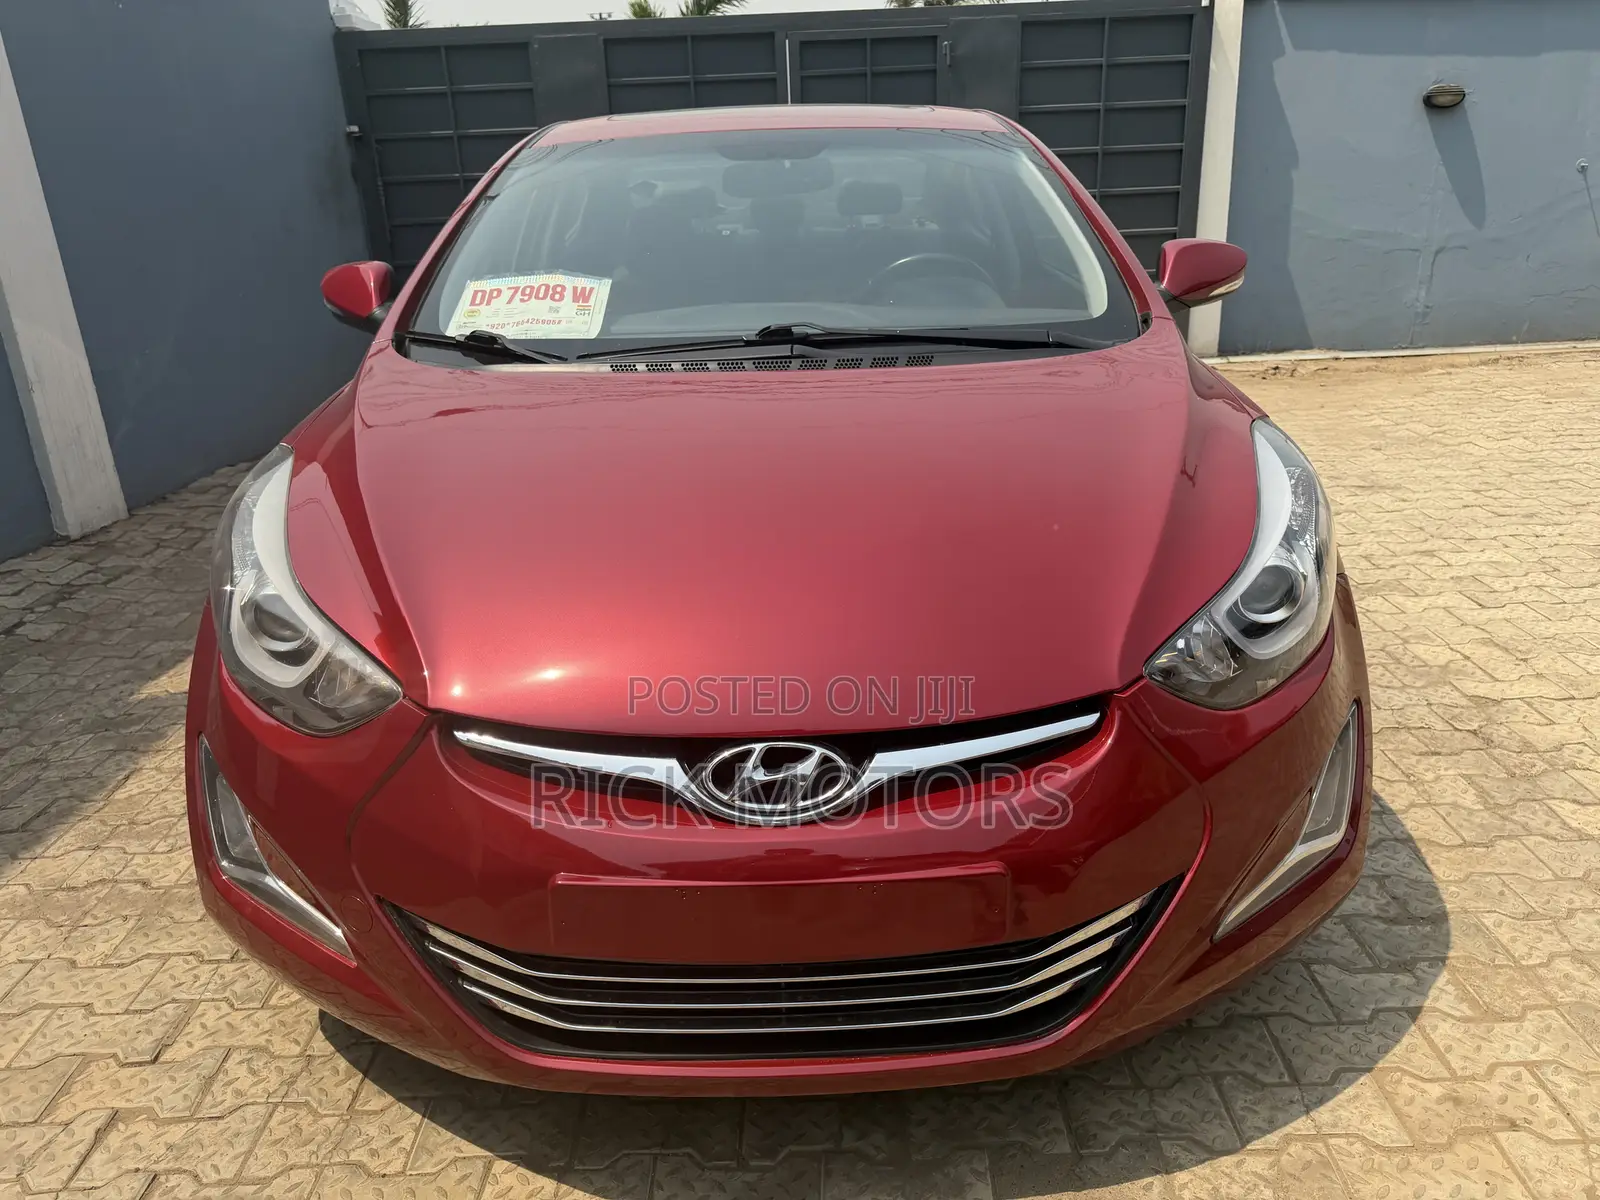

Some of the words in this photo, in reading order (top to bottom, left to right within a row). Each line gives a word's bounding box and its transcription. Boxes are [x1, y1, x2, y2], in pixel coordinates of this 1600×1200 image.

[469, 287, 503, 307] DP
[505, 283, 567, 305] 7908
[571, 285, 596, 304] W
